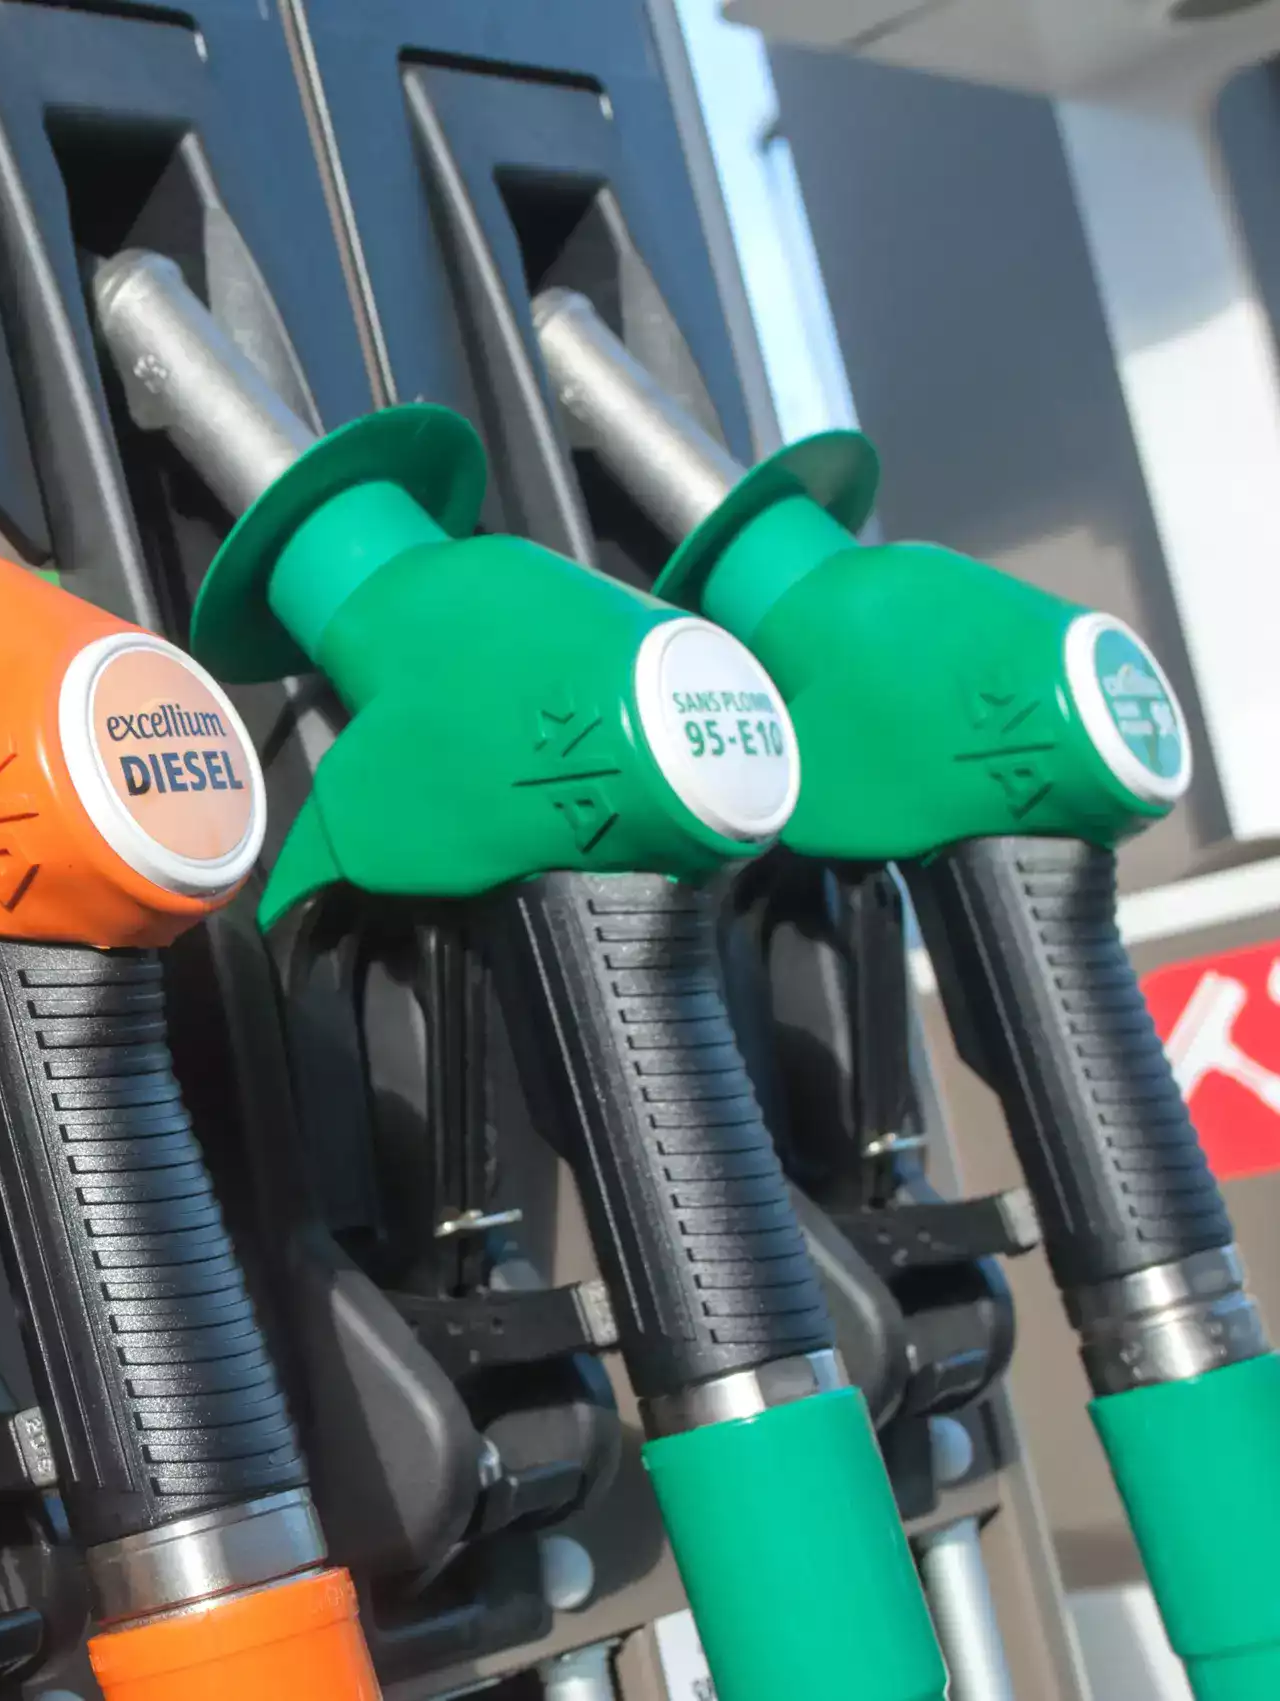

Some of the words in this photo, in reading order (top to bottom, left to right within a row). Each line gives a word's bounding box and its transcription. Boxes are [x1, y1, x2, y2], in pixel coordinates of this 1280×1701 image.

[672, 692, 721, 714] SANS
[107, 704, 227, 742] excellium
[685, 720, 784, 757] 95-E10
[120, 751, 244, 796] DIESEL
